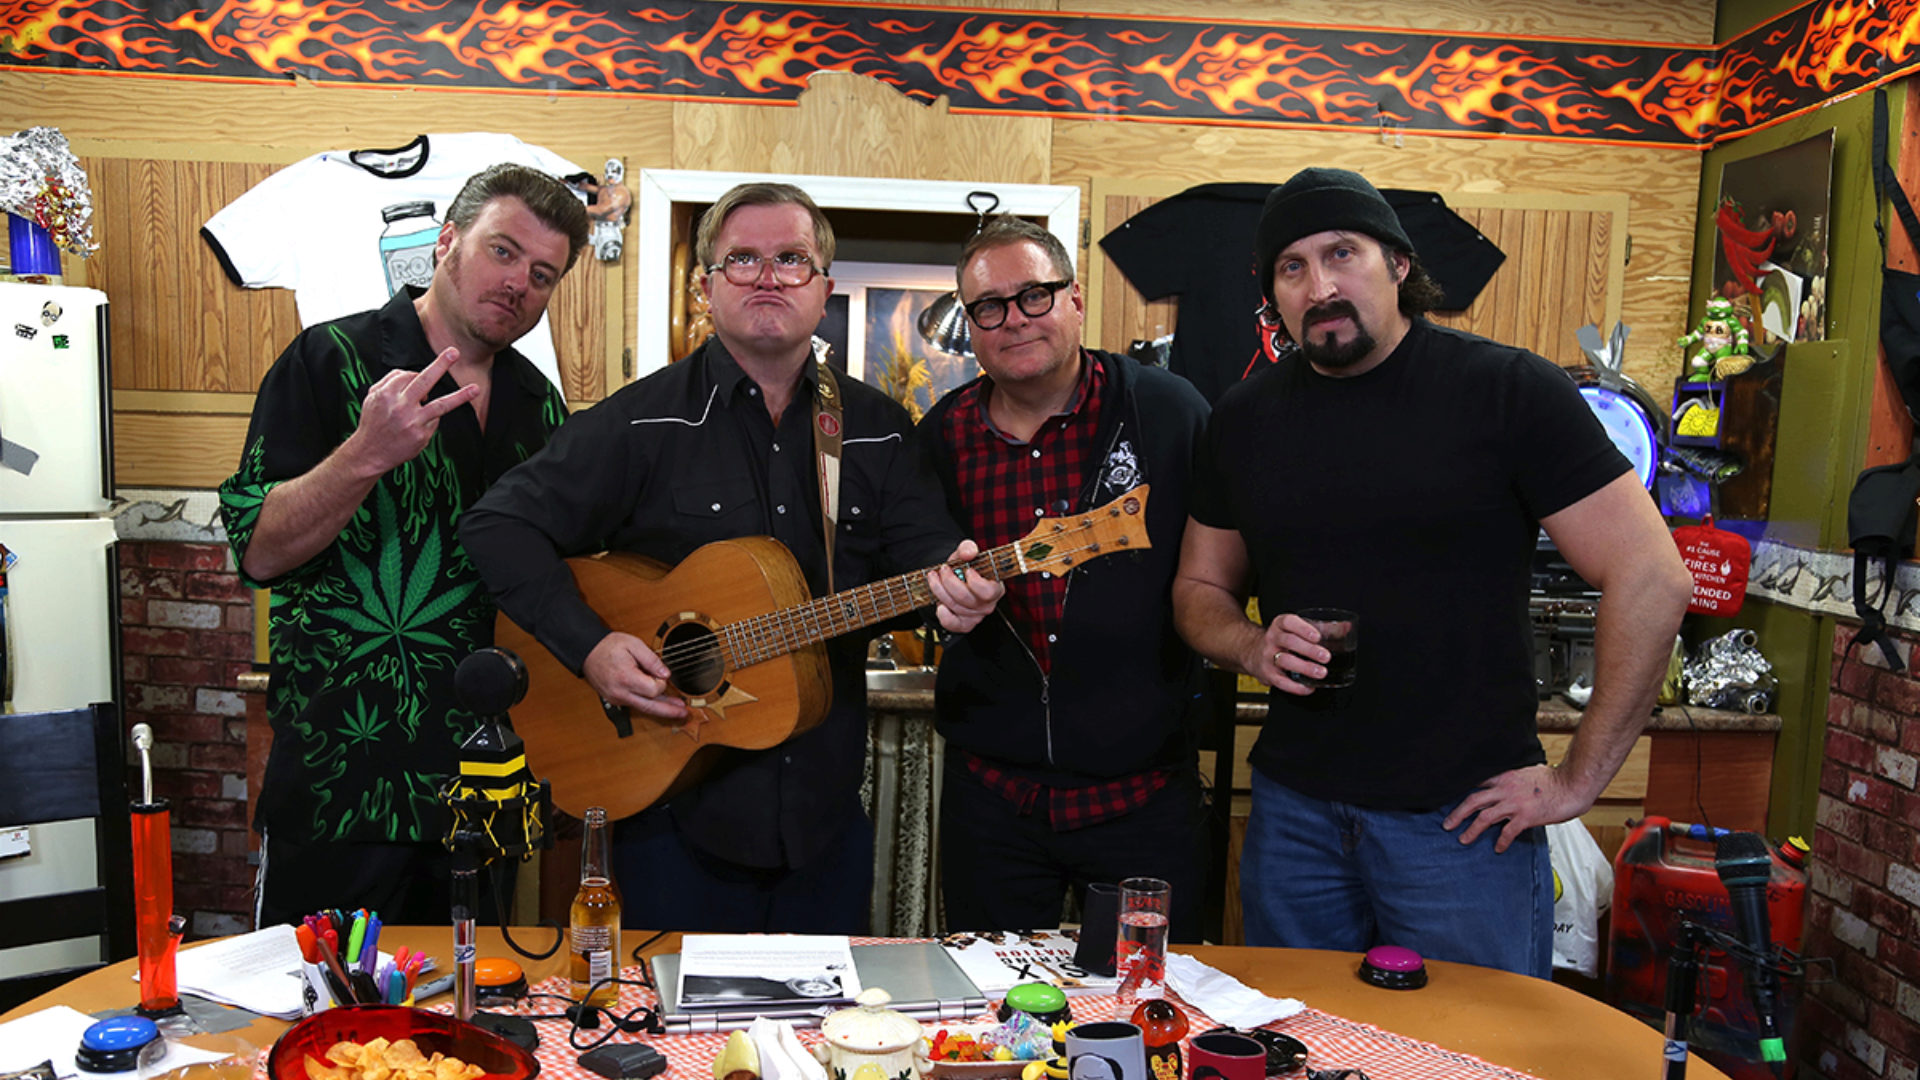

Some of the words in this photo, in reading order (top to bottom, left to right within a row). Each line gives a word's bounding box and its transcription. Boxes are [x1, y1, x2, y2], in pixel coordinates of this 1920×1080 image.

[1697, 546, 1720, 557] CAUSE
[1684, 558, 1718, 573] FIRES
[994, 948, 1071, 958] NATION
